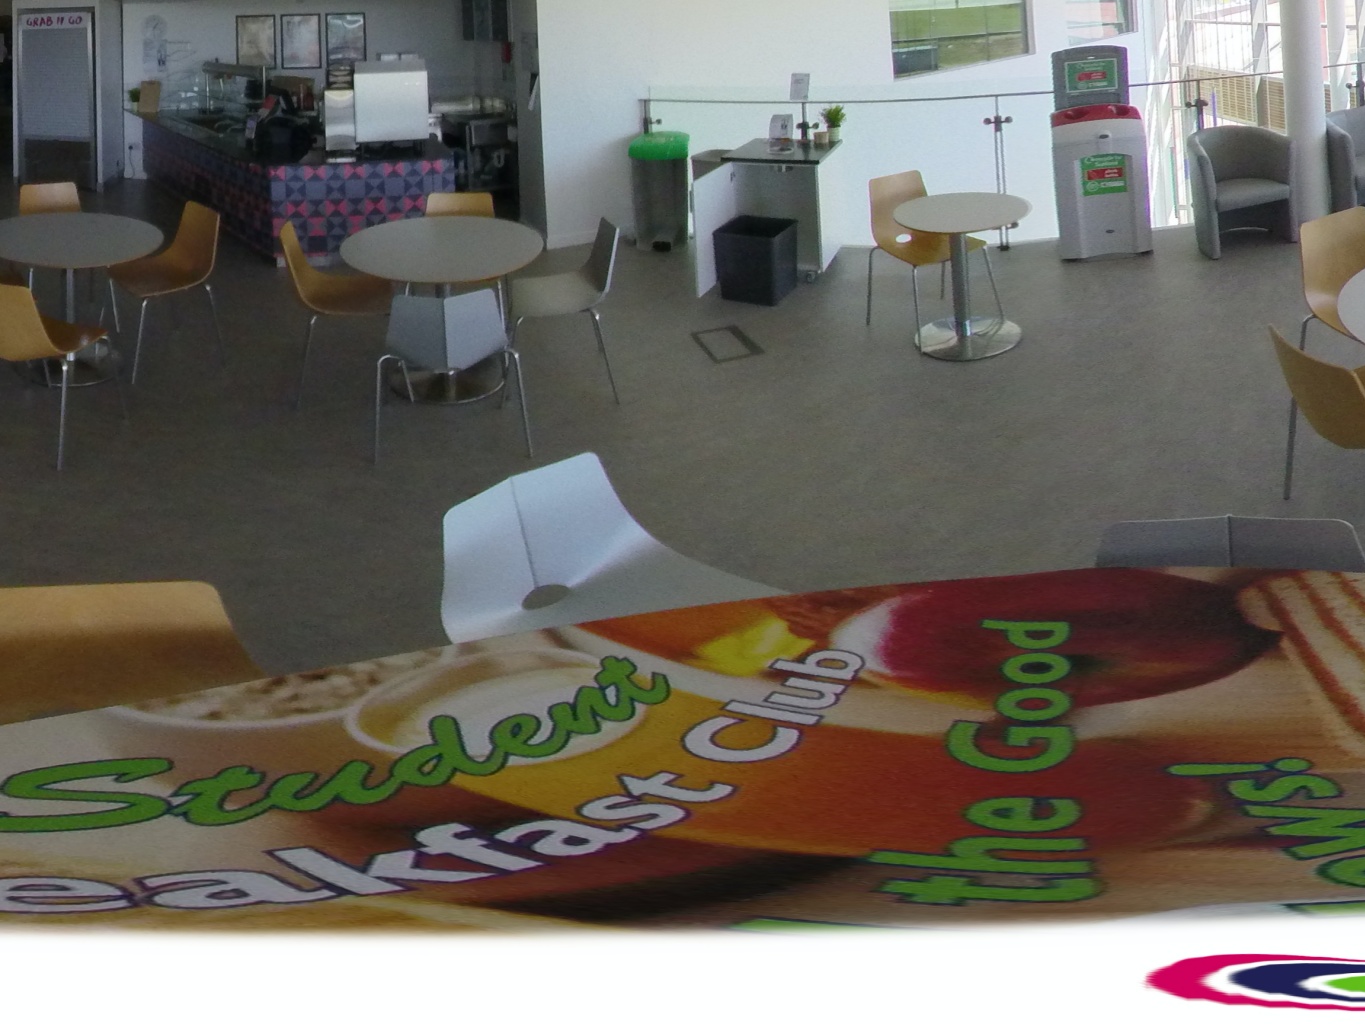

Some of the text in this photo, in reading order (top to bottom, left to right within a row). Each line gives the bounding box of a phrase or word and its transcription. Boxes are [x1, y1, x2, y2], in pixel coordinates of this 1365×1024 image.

[26, 16, 53, 27] GRAB
[68, 15, 83, 25] GO
[0, 656, 669, 833] Student
[682, 648, 867, 764] Club
[864, 618, 1107, 907] the Good
